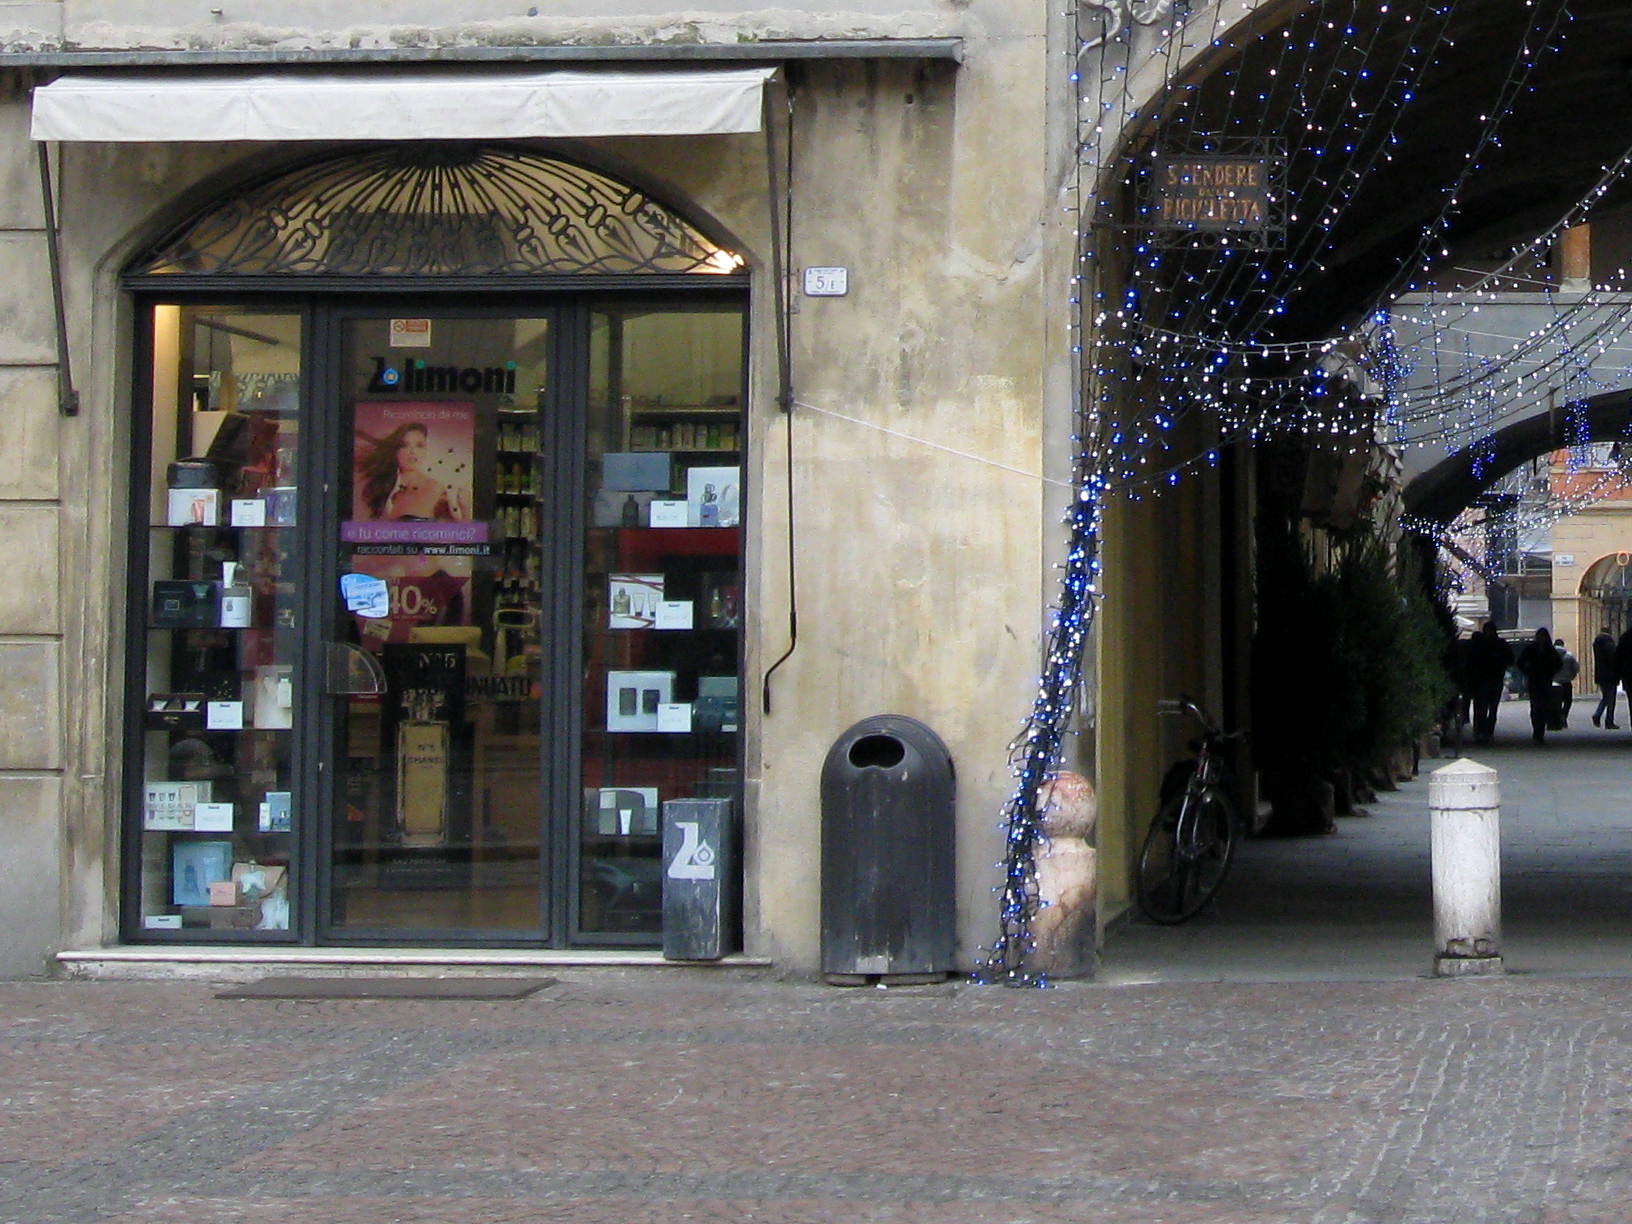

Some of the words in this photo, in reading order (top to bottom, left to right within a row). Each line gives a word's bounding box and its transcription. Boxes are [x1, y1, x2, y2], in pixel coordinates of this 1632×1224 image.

[405, 357, 517, 393] limoni
[375, 529, 409, 539] come
[423, 545, 491, 555] www.limoni.it
